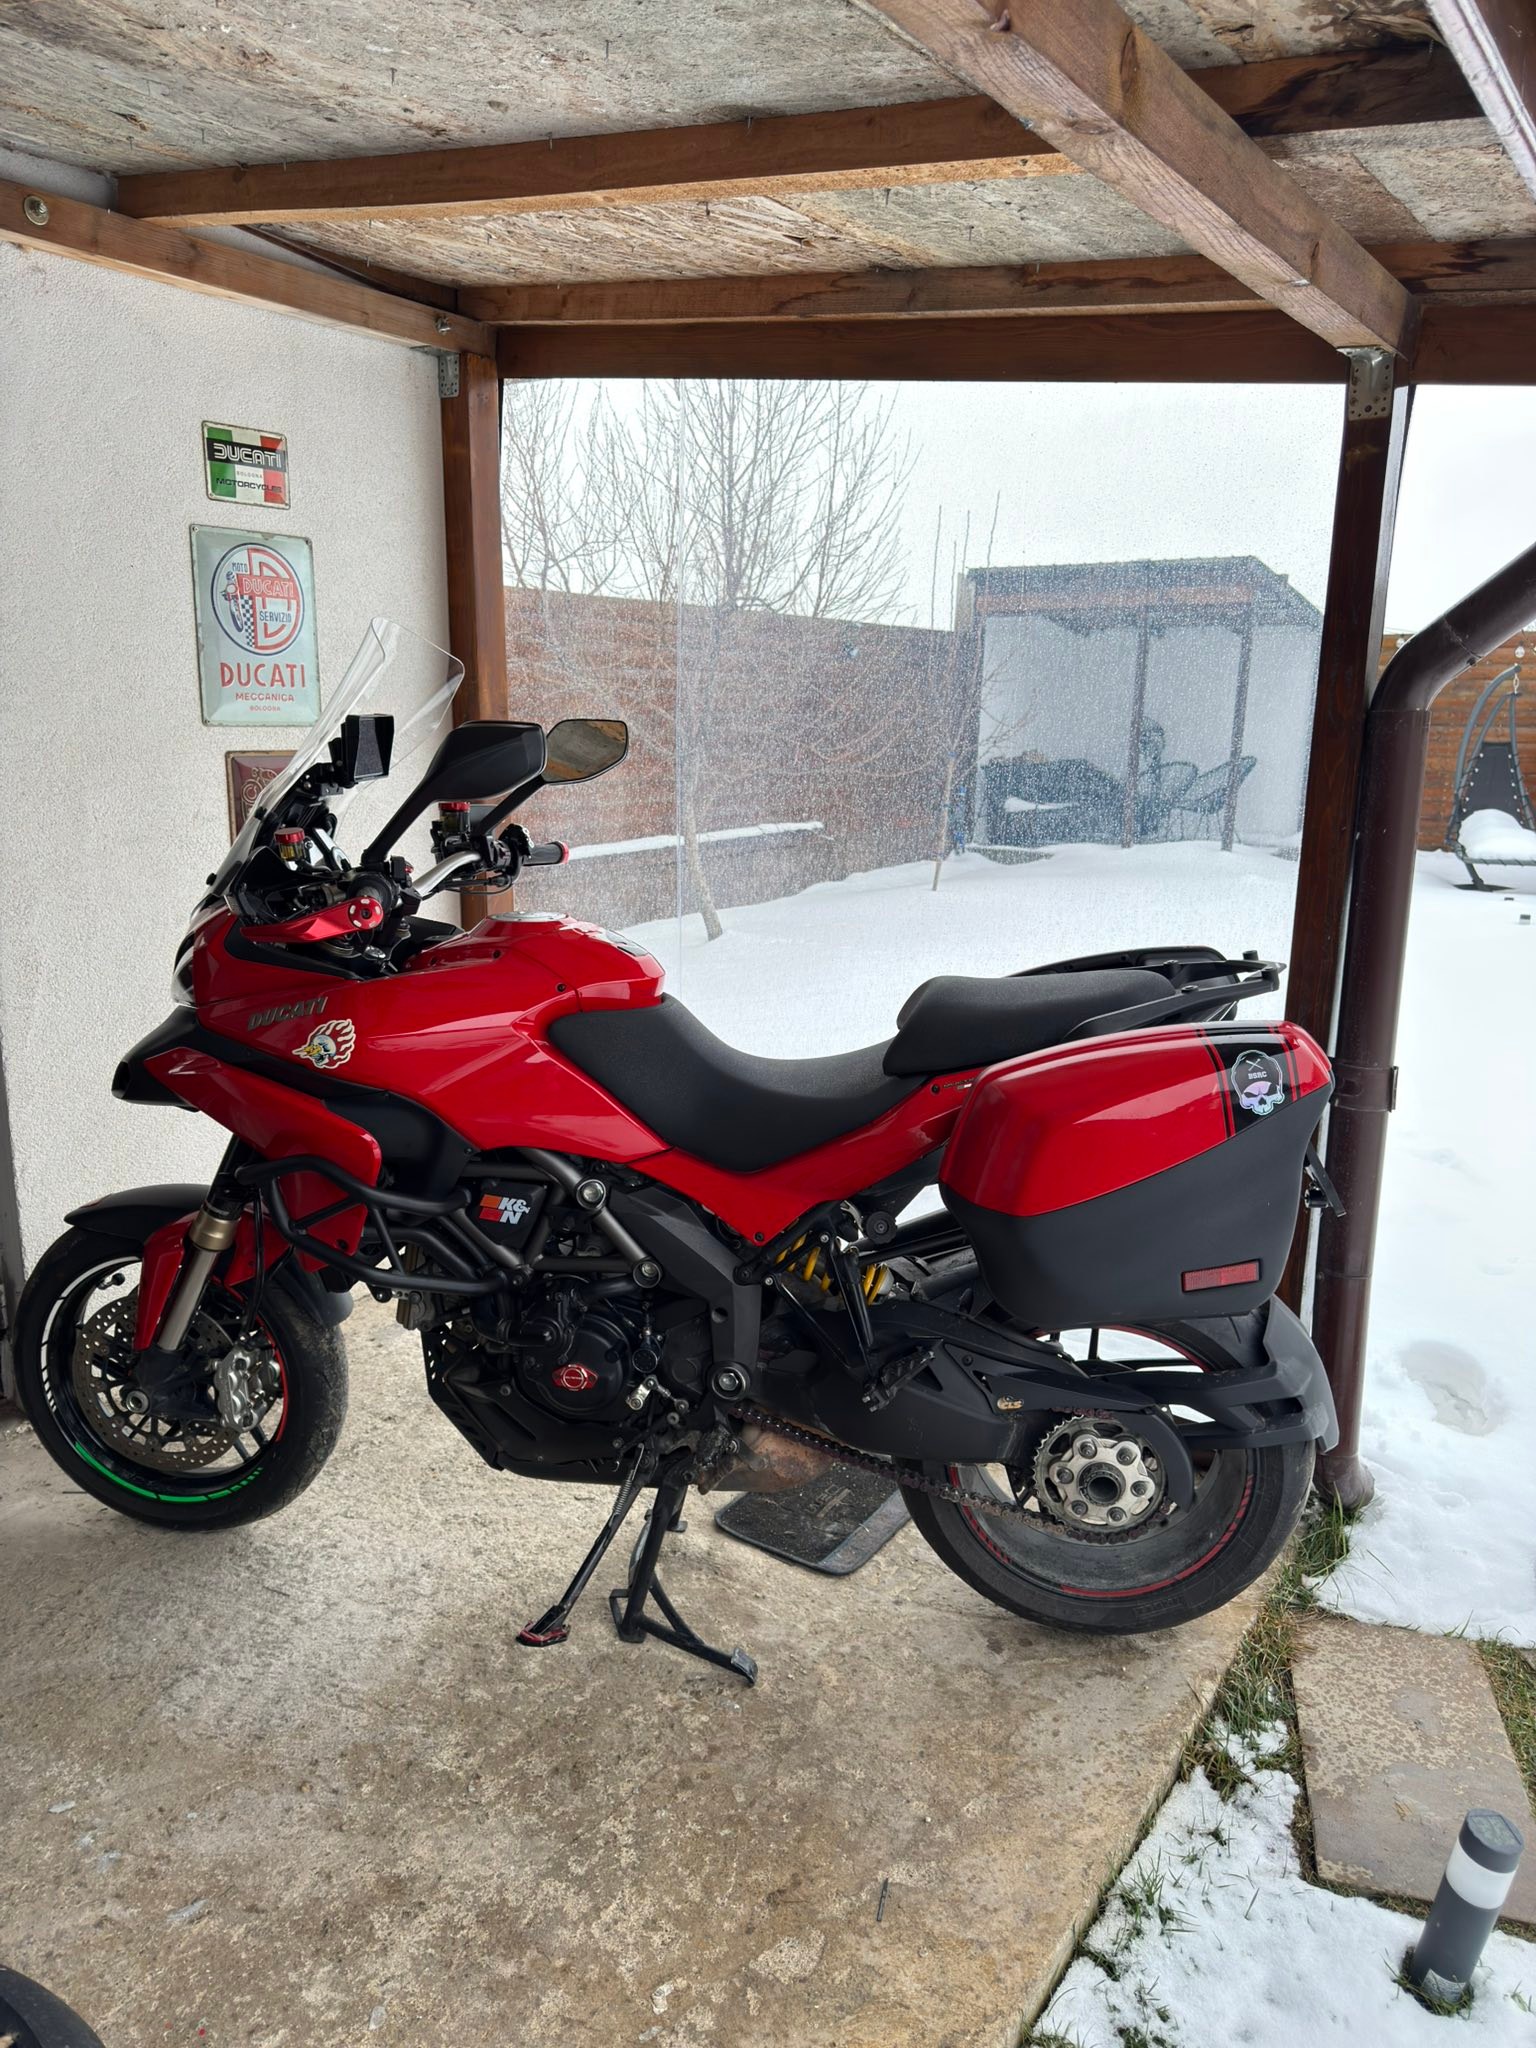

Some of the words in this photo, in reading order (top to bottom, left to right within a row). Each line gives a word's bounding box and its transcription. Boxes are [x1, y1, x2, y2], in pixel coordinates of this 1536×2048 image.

[213, 443, 282, 468] DUCATI
[231, 562, 248, 573] MOTO
[242, 577, 294, 597] DUCATI
[259, 611, 292, 623] SERVIZIO
[220, 662, 306, 688] DUCATI
[235, 692, 295, 702] MECCANICA
[247, 996, 328, 1031] DUCATI
